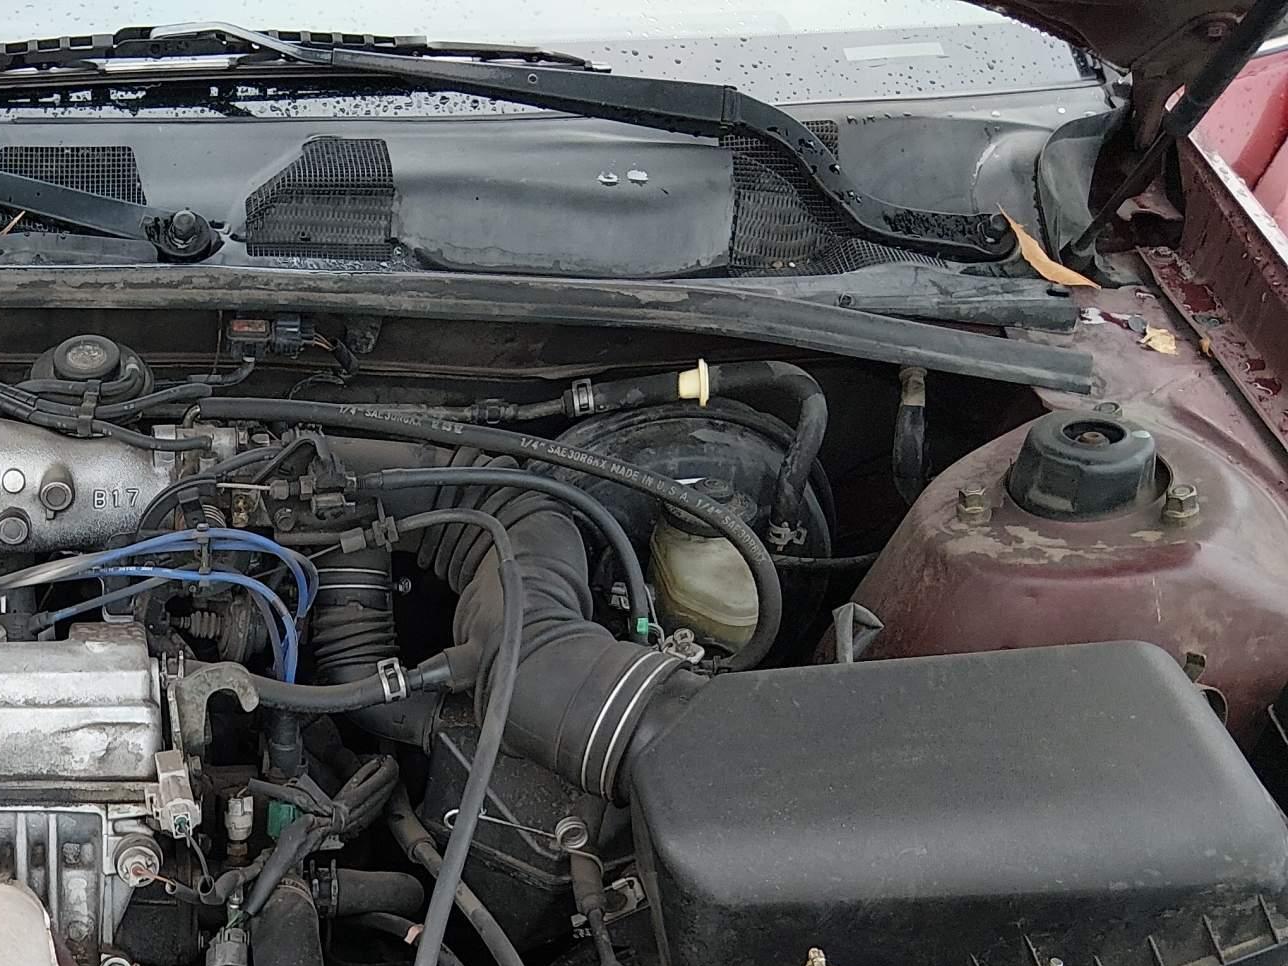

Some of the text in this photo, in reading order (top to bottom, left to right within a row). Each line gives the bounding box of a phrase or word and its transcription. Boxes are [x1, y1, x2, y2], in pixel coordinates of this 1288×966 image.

[520, 437, 546, 451] 1/4"
[610, 463, 640, 481] MADE
[641, 474, 654, 486] IN
